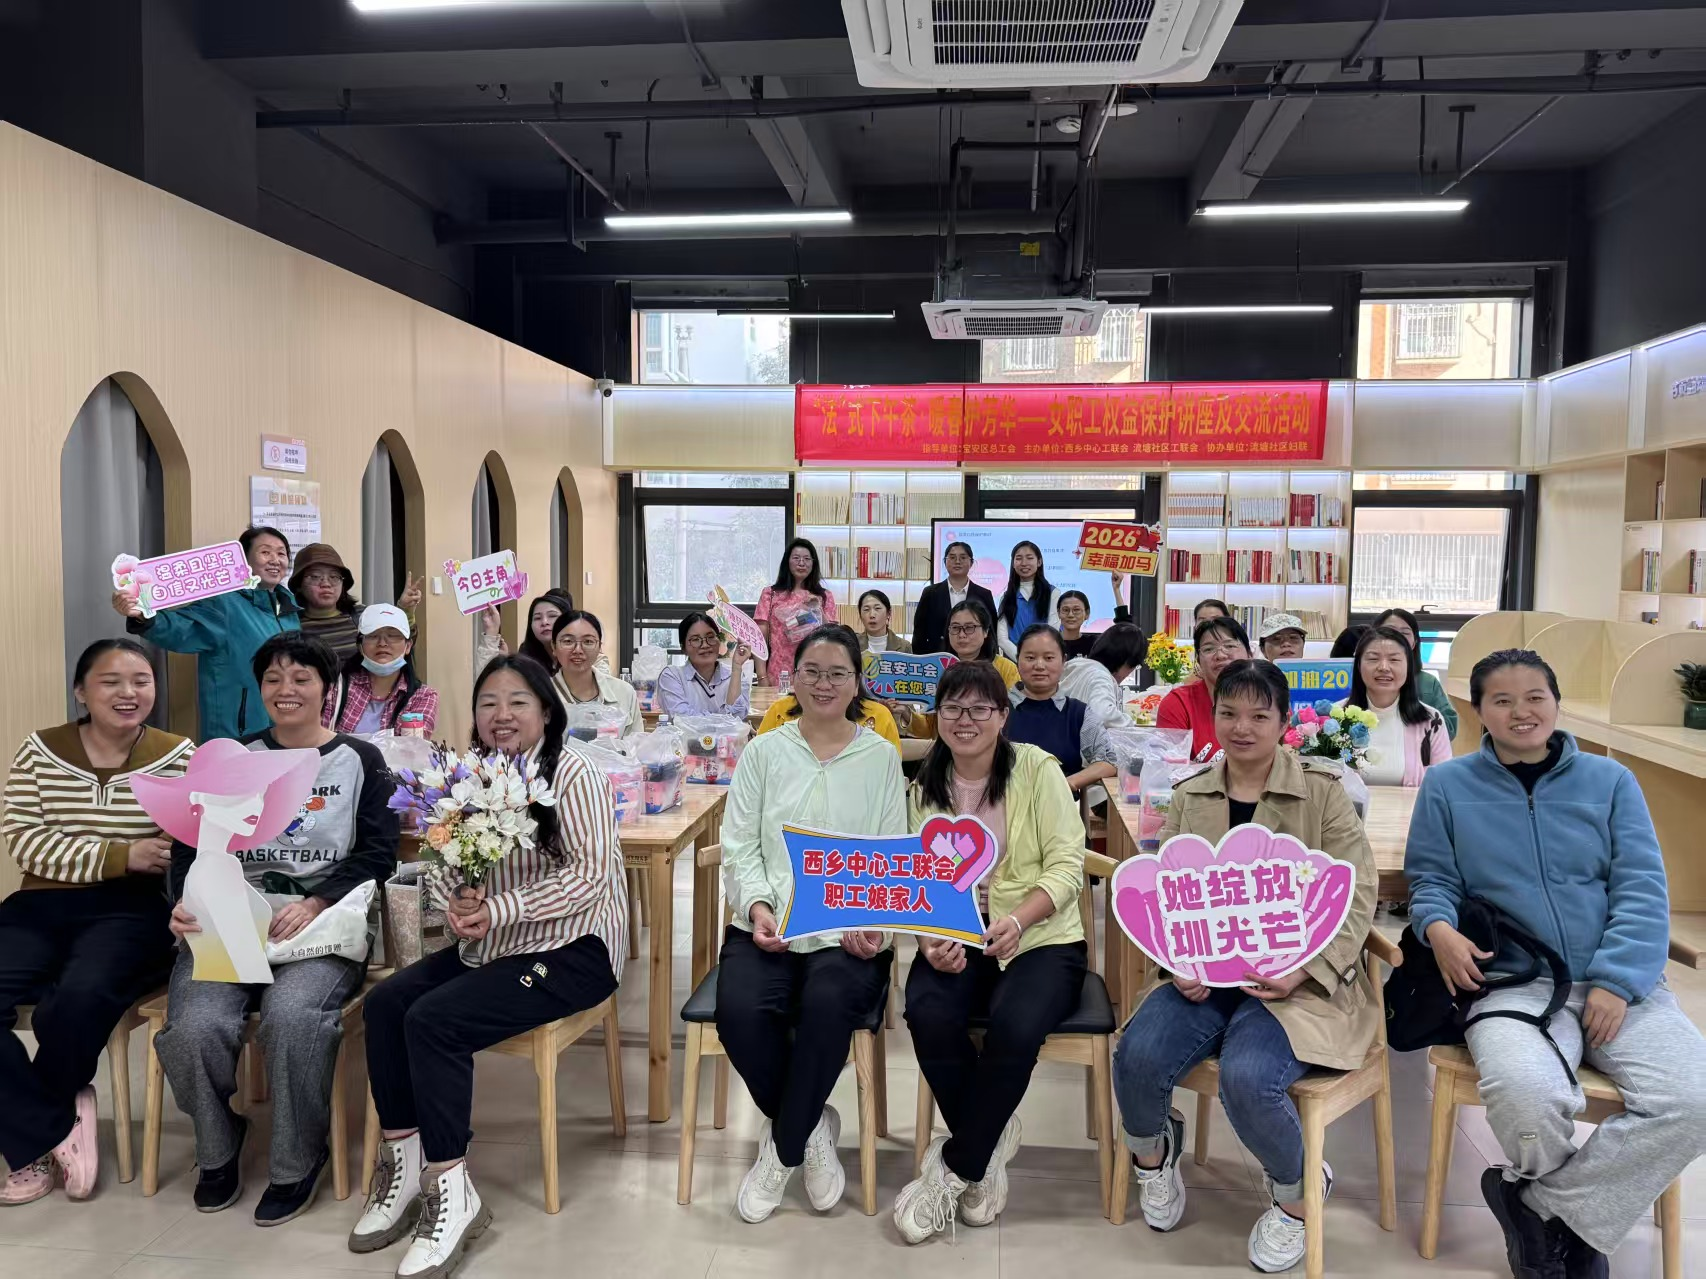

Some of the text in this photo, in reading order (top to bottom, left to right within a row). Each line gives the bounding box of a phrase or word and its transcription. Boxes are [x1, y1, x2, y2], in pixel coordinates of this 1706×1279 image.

[1084, 526, 1137, 548] 2026
[155, 550, 236, 581] 温柔且坚定
[1087, 552, 1152, 571] 幸福加马
[152, 569, 231, 601] 自信又光芒
[456, 565, 509, 593] 今日主角
[879, 660, 938, 678] 宝安工会
[894, 679, 937, 696] 在您身
[235, 848, 339, 863] BASKETBALL
[802, 848, 957, 882] 西乡中心工联会
[823, 882, 934, 914] 职工娘家人
[1161, 863, 1296, 913] 她绽放
[1170, 910, 1302, 958] 圳光芒
